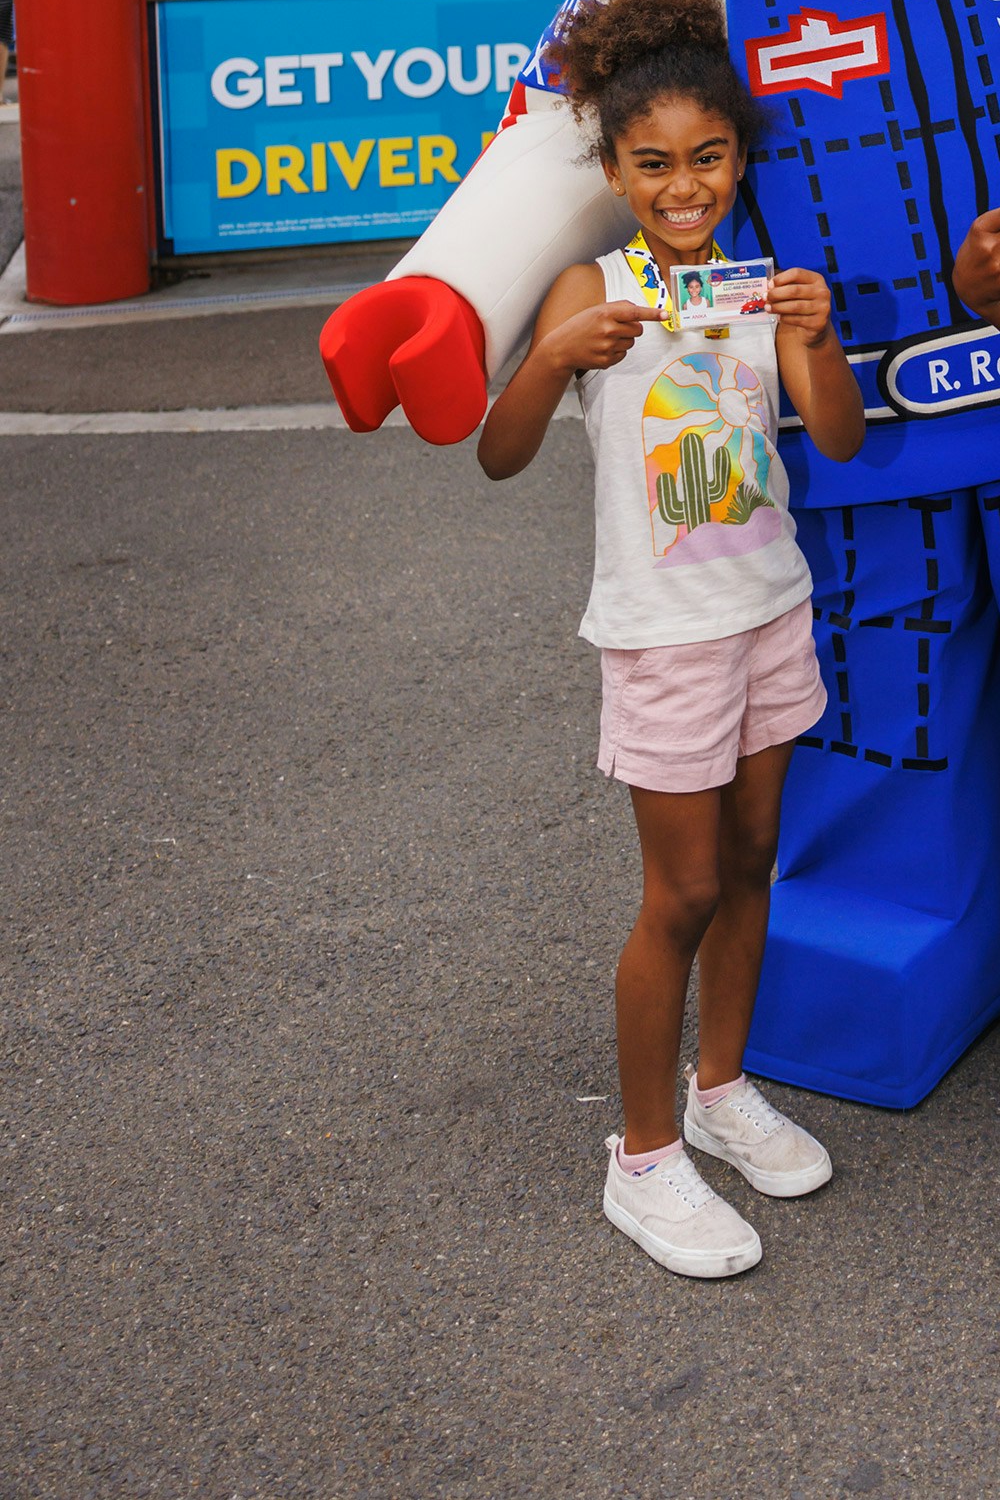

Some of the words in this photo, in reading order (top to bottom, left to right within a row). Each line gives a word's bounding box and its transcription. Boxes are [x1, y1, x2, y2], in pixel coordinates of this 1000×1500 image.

[210, 52, 343, 109] GET
[352, 43, 530, 100] YOUR
[216, 136, 461, 198] DRIVER
[928, 360, 961, 394] R.
